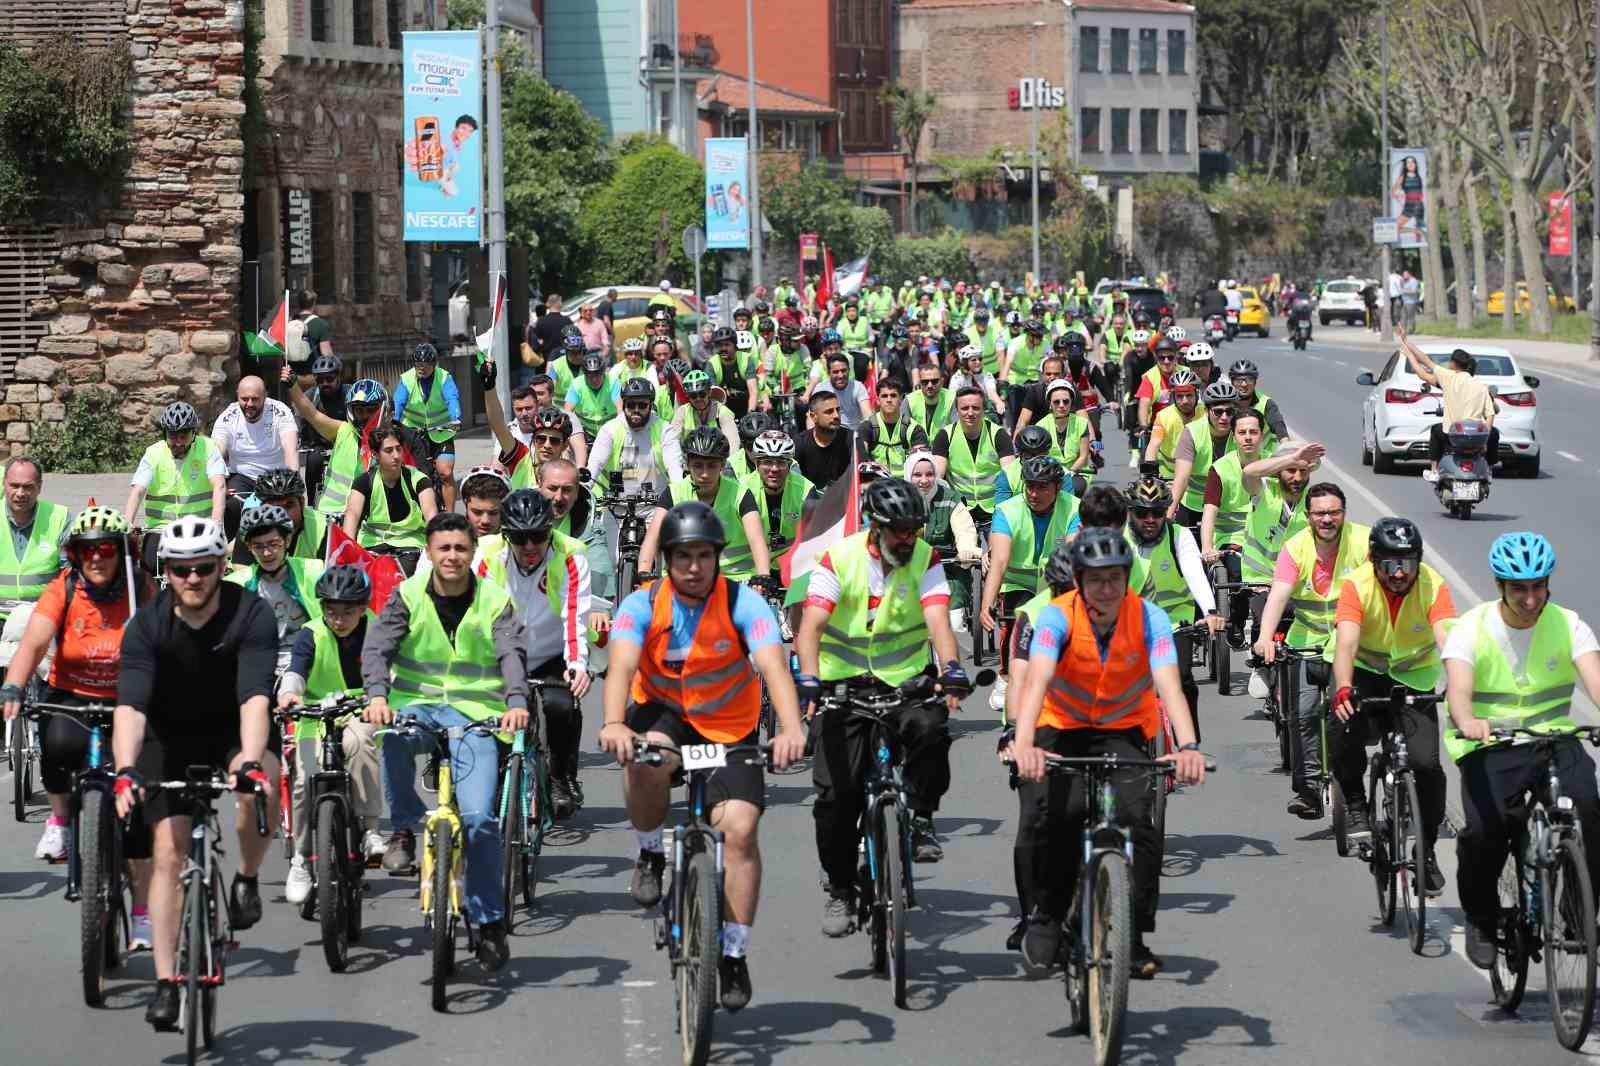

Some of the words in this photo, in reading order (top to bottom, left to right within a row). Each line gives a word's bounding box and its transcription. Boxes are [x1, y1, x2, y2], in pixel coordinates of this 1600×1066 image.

[1008, 78, 1064, 108] eOfis
[406, 208, 477, 228] NESCAFÉ
[689, 743, 717, 760] 60
